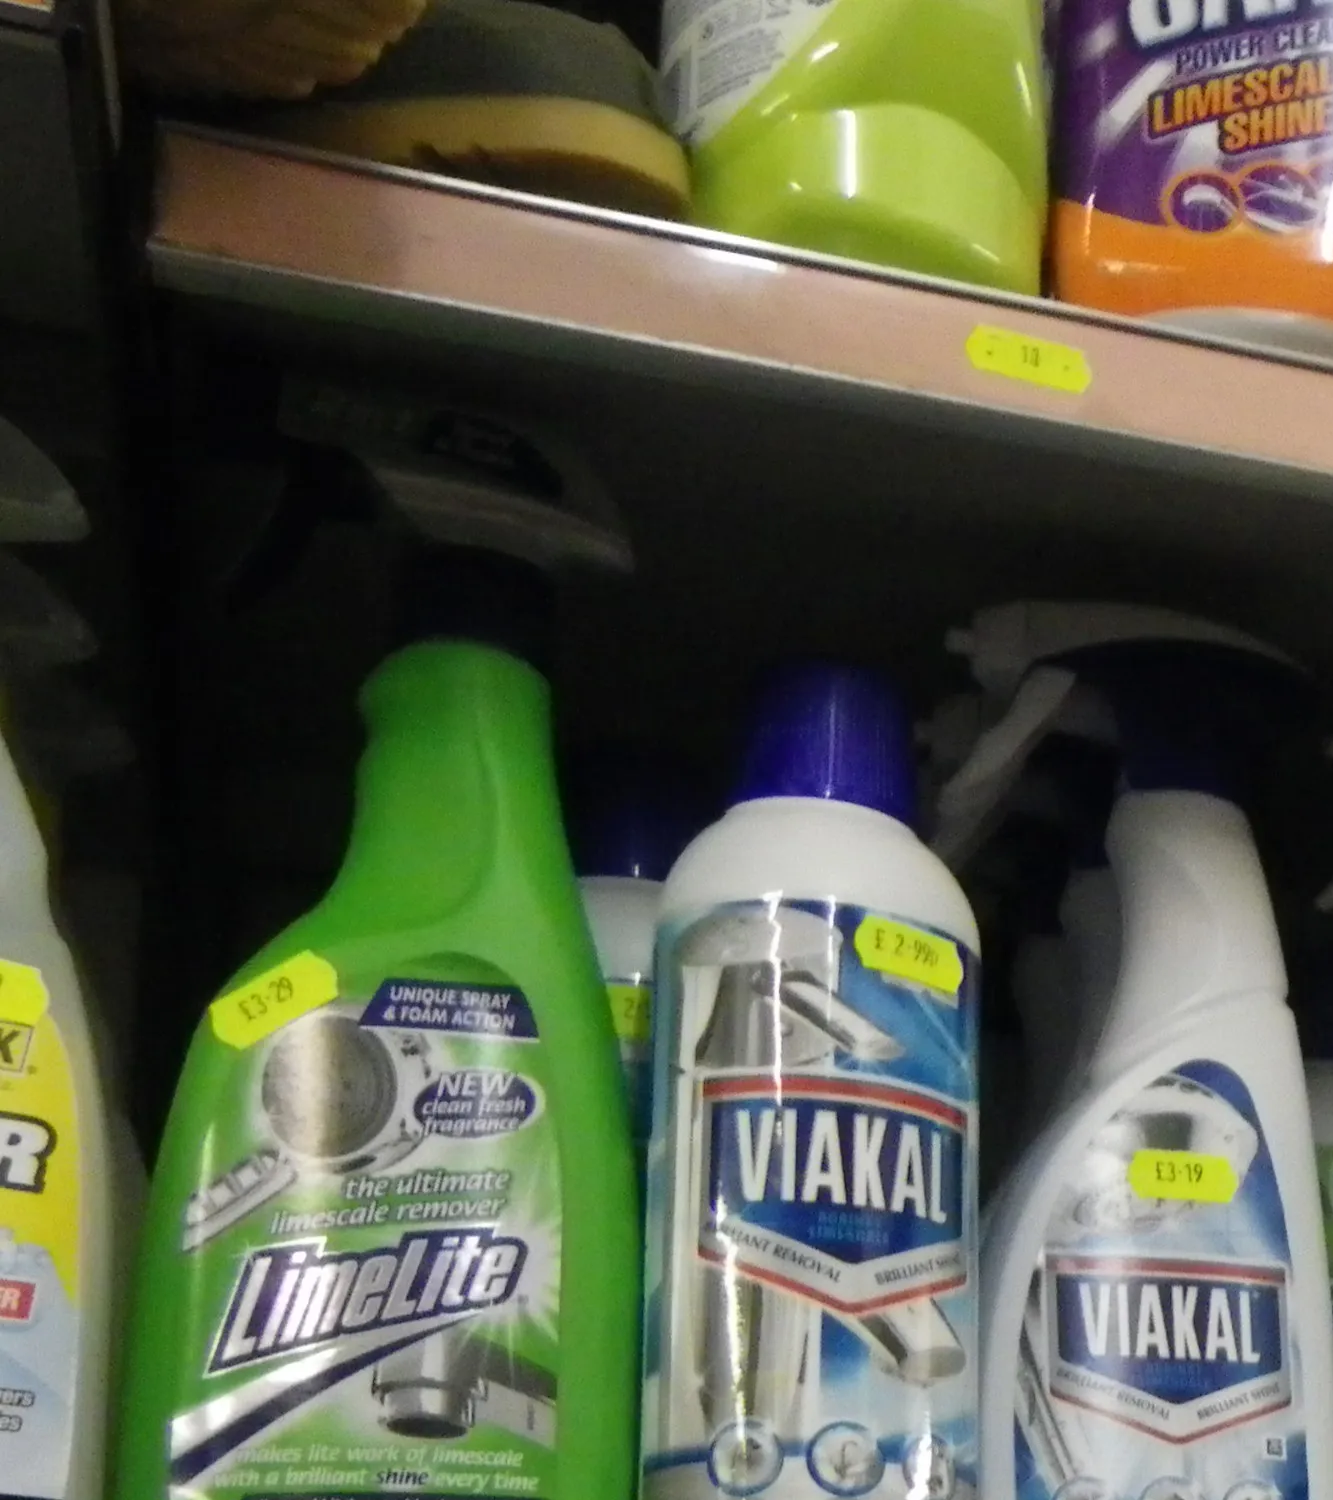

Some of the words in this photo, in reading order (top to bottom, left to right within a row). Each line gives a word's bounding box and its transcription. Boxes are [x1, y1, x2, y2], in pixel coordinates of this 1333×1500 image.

[389, 986, 455, 1006] UNIQUE
[461, 990, 512, 1009] SPRAY
[400, 1004, 450, 1025] FOAM
[454, 1007, 516, 1030] ACTION
[436, 1072, 517, 1098] NEW
[421, 1094, 473, 1116] clean
[478, 1094, 527, 1118] fresh
[423, 1114, 521, 1137] fragrance
[735, 1107, 949, 1223] VIAKAL
[346, 1172, 390, 1199] the
[396, 1168, 510, 1195] ultimate
[271, 1201, 388, 1235] limescale
[396, 1196, 502, 1223] remover
[773, 1239, 841, 1283] REMOVAL
[223, 1235, 518, 1362] LimeLite
[1079, 1282, 1261, 1363] VIAKAL
[233, 1445, 302, 1464] makes
[308, 1444, 339, 1462] lite
[346, 1445, 398, 1464] work
[406, 1445, 427, 1466] of
[432, 1445, 524, 1467] limescale
[213, 1468, 259, 1487] with
[285, 1466, 367, 1487] brilliant
[375, 1468, 429, 1487] shine
[435, 1471, 488, 1493] every
[493, 1471, 539, 1491] time
